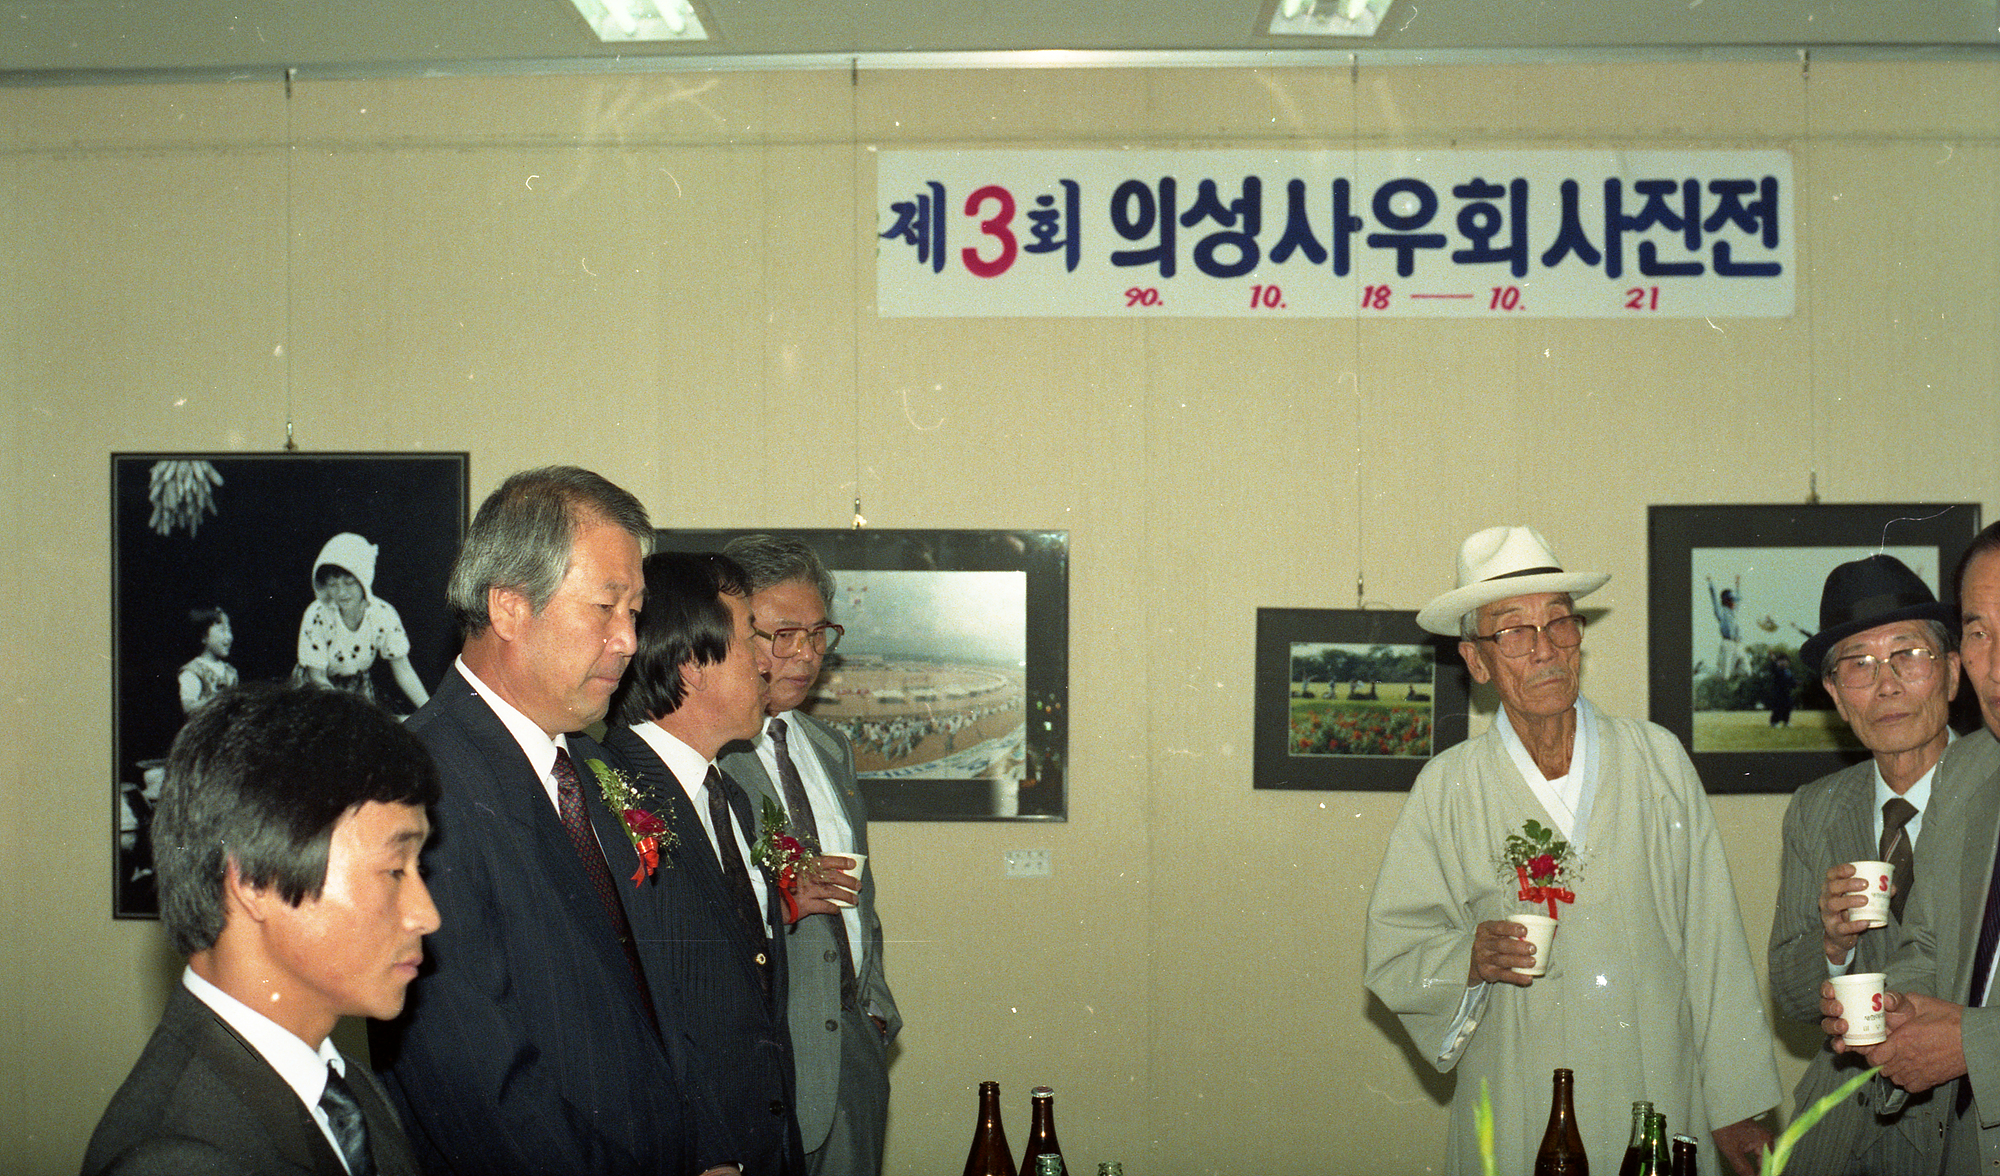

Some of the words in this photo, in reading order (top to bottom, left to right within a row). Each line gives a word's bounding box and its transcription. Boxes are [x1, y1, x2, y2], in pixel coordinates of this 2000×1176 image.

[1249, 284, 1286, 309] 10.
[1361, 284, 1392, 310] 18
[1489, 285, 1525, 311] 10.
[1624, 286, 1659, 310] 21
[1871, 992, 1883, 1013] S
